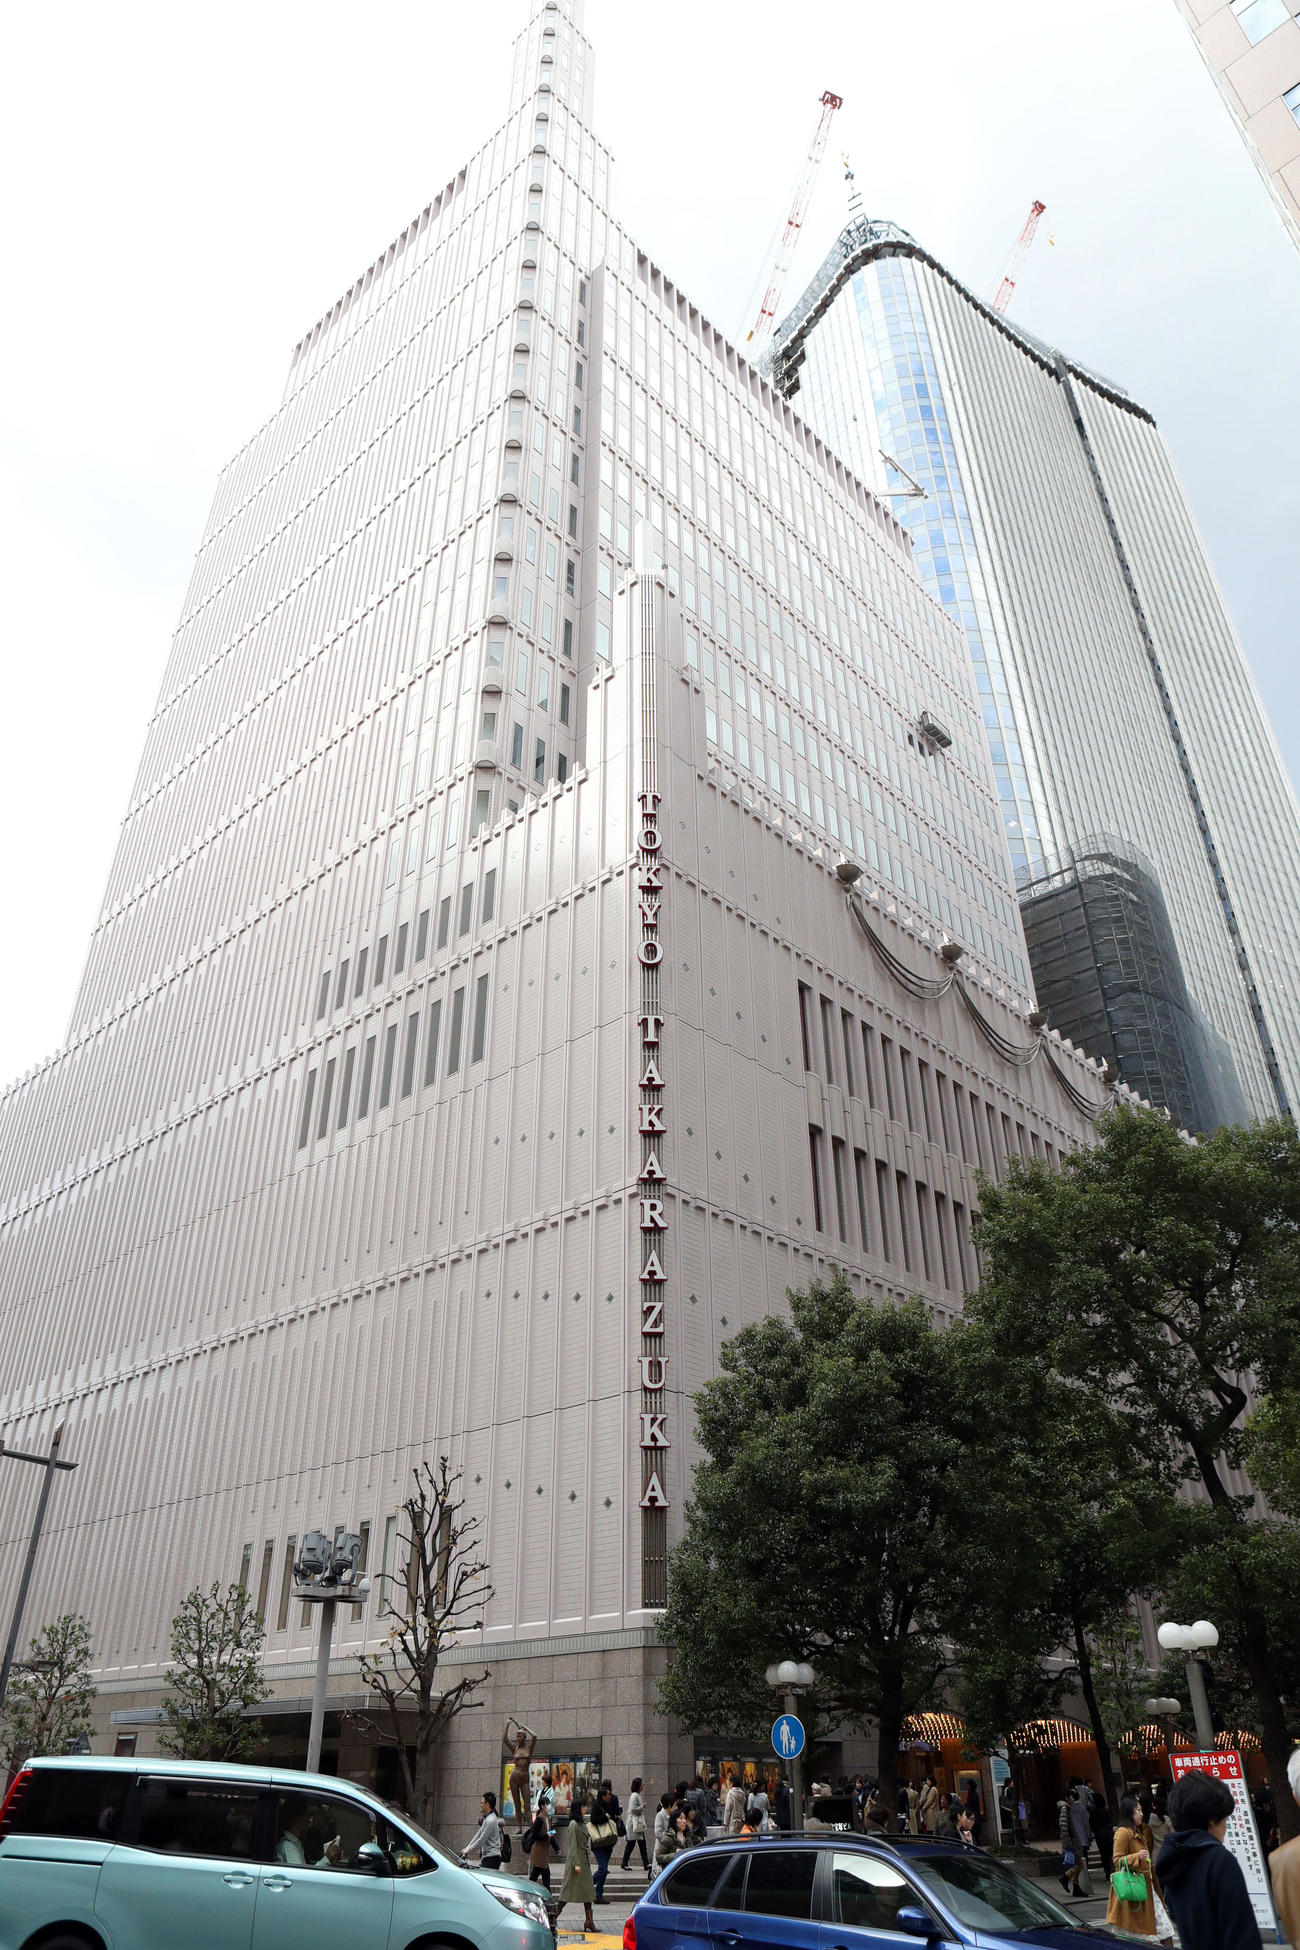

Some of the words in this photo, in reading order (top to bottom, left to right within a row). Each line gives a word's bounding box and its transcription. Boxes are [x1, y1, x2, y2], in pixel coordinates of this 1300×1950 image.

[637, 792, 664, 968] TOKYO
[637, 1014, 671, 1508] TAKARAZUKA
[1174, 1754, 1236, 1768] 車両通行止めの
[1176, 1766, 1238, 1779] おらせ
